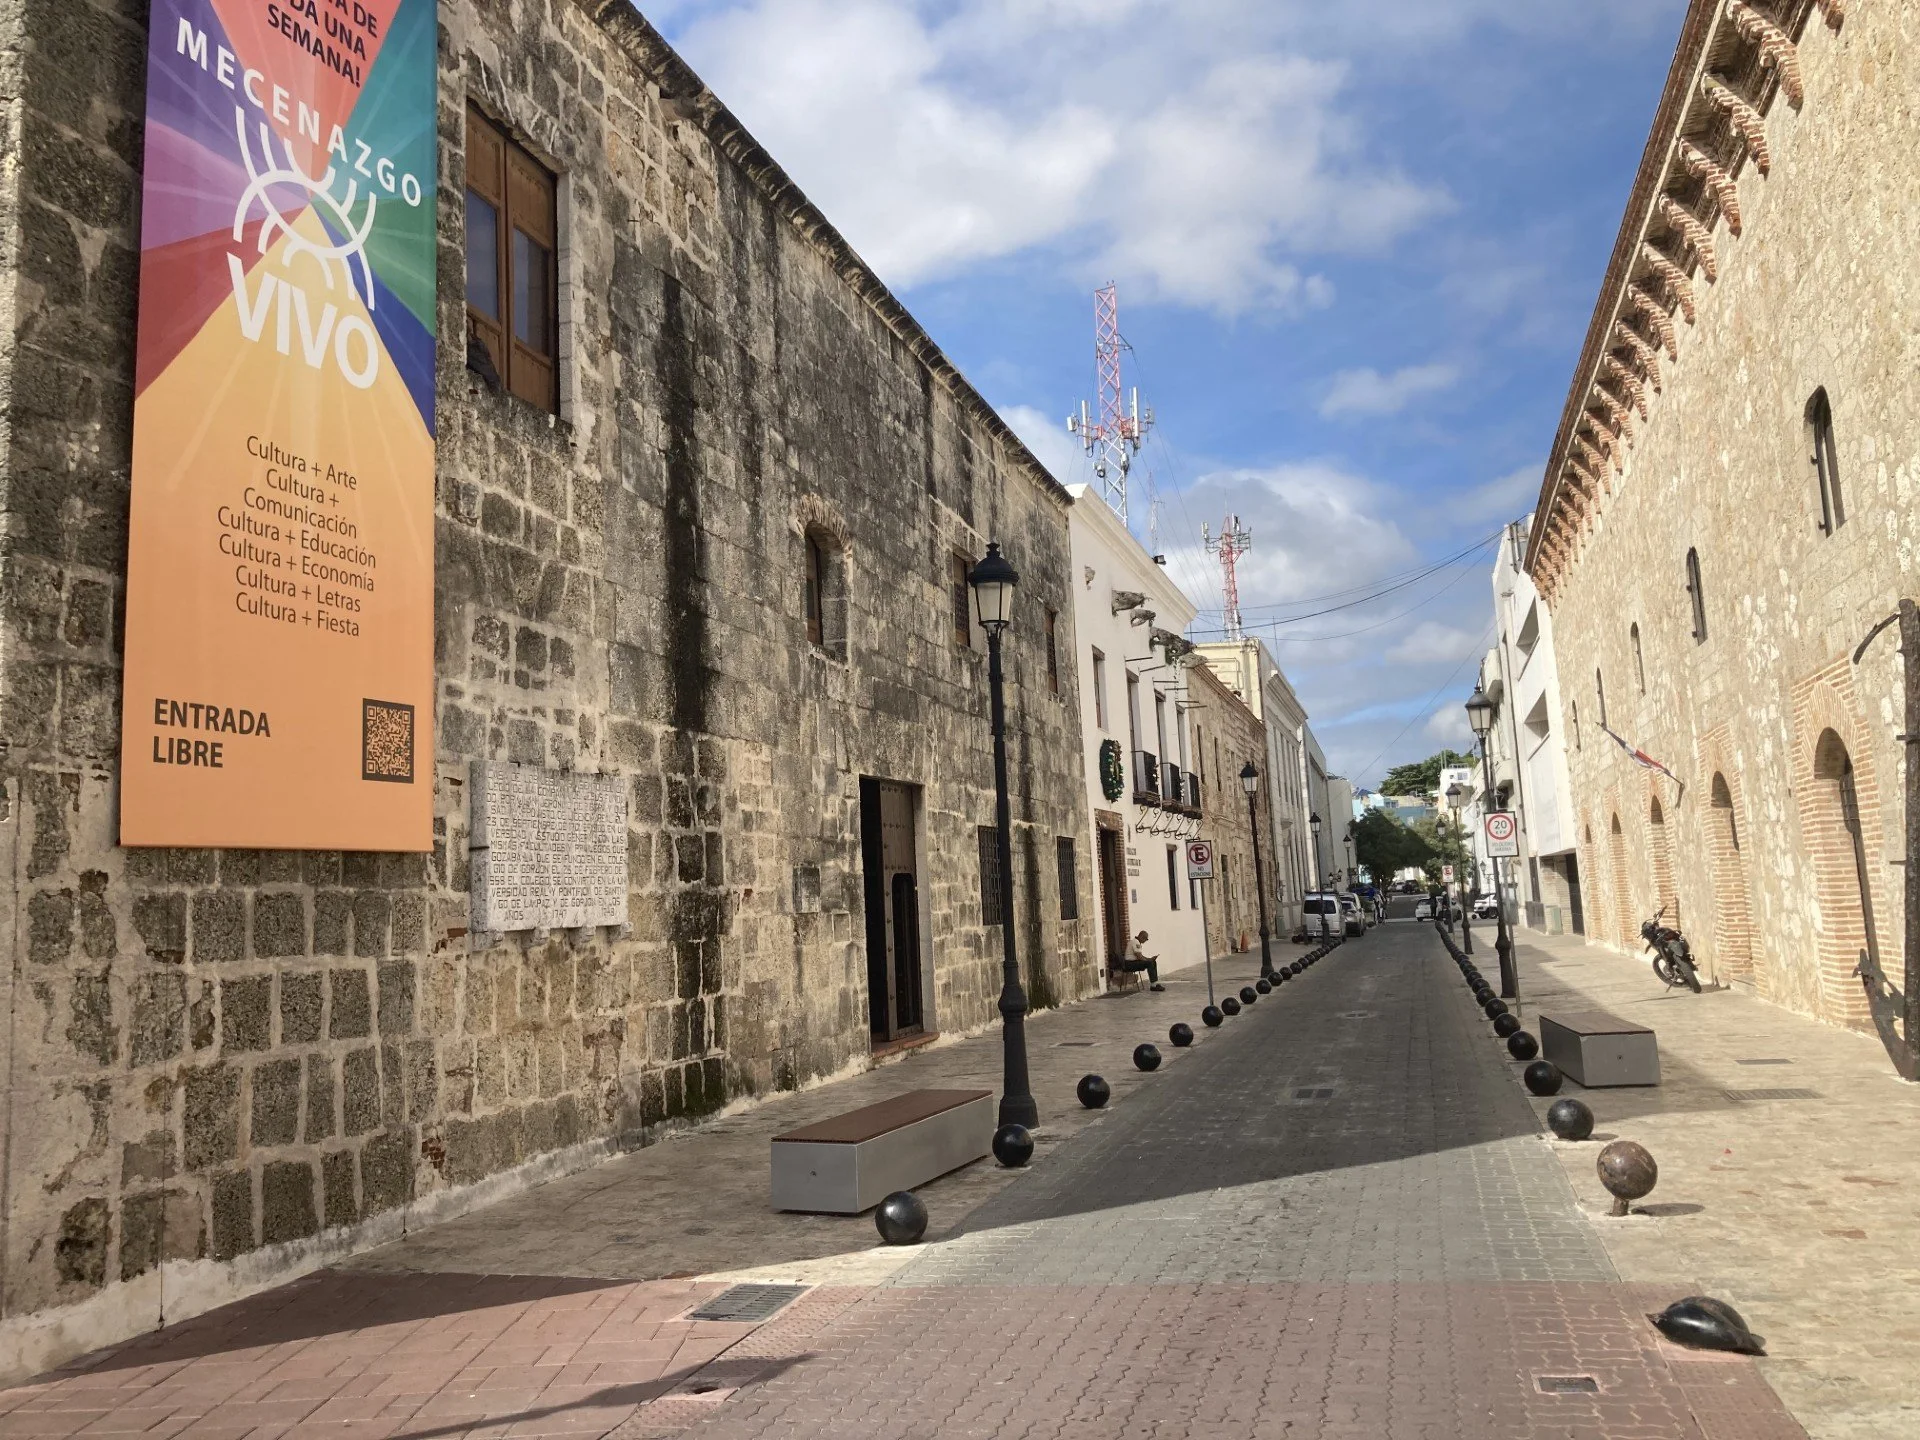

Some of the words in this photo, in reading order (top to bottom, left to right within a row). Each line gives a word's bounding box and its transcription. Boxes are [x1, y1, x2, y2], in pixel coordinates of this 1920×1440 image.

[325, 11, 367, 61] UNA
[353, 2, 378, 38] DE
[268, 3, 361, 88] SEMANA!
[177, 17, 421, 207] MECENAZGO
[227, 252, 379, 390] VIVO
[247, 435, 306, 474] Cultura
[311, 463, 322, 477] +
[326, 463, 357, 490] Arte
[266, 468, 325, 504] Cultura
[329, 494, 340, 507] +
[218, 506, 280, 542] Cultura
[285, 530, 296, 545] +
[301, 529, 377, 569] Educación
[243, 487, 357, 539] Comunicación
[219, 533, 281, 567] Cultura
[286, 556, 297, 571] +
[302, 555, 375, 592] Economía
[236, 565, 296, 598] Cultura
[301, 586, 312, 600] +
[317, 583, 361, 613] Letras
[236, 592, 296, 624] Cultura
[301, 611, 312, 626] +
[317, 610, 360, 637] Fiesta
[155, 698, 271, 737] ENTRADA
[153, 735, 224, 768] LIBRE
[1494, 820, 1507, 829] 20
